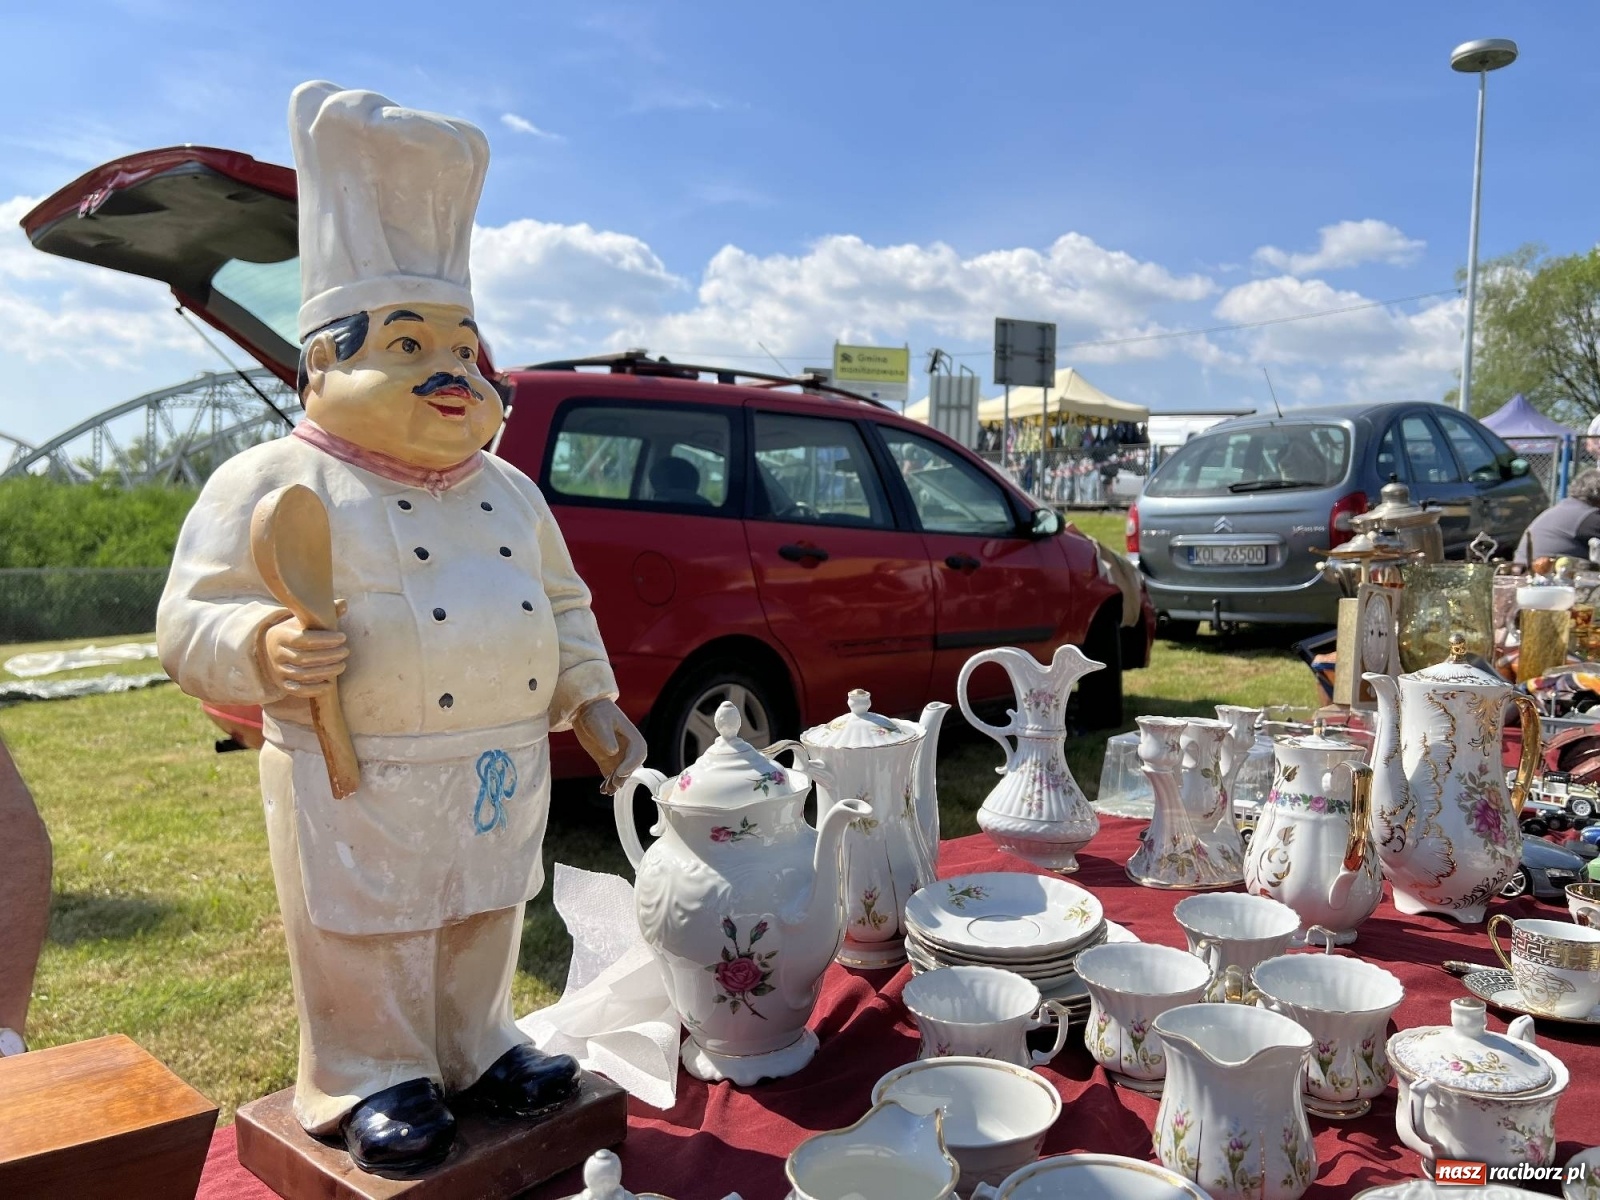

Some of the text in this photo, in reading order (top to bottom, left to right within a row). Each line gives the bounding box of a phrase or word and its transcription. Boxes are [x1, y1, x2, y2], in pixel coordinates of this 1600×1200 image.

[857, 353, 889, 364] Gmina
[1196, 547, 1264, 562] KOL 26500
